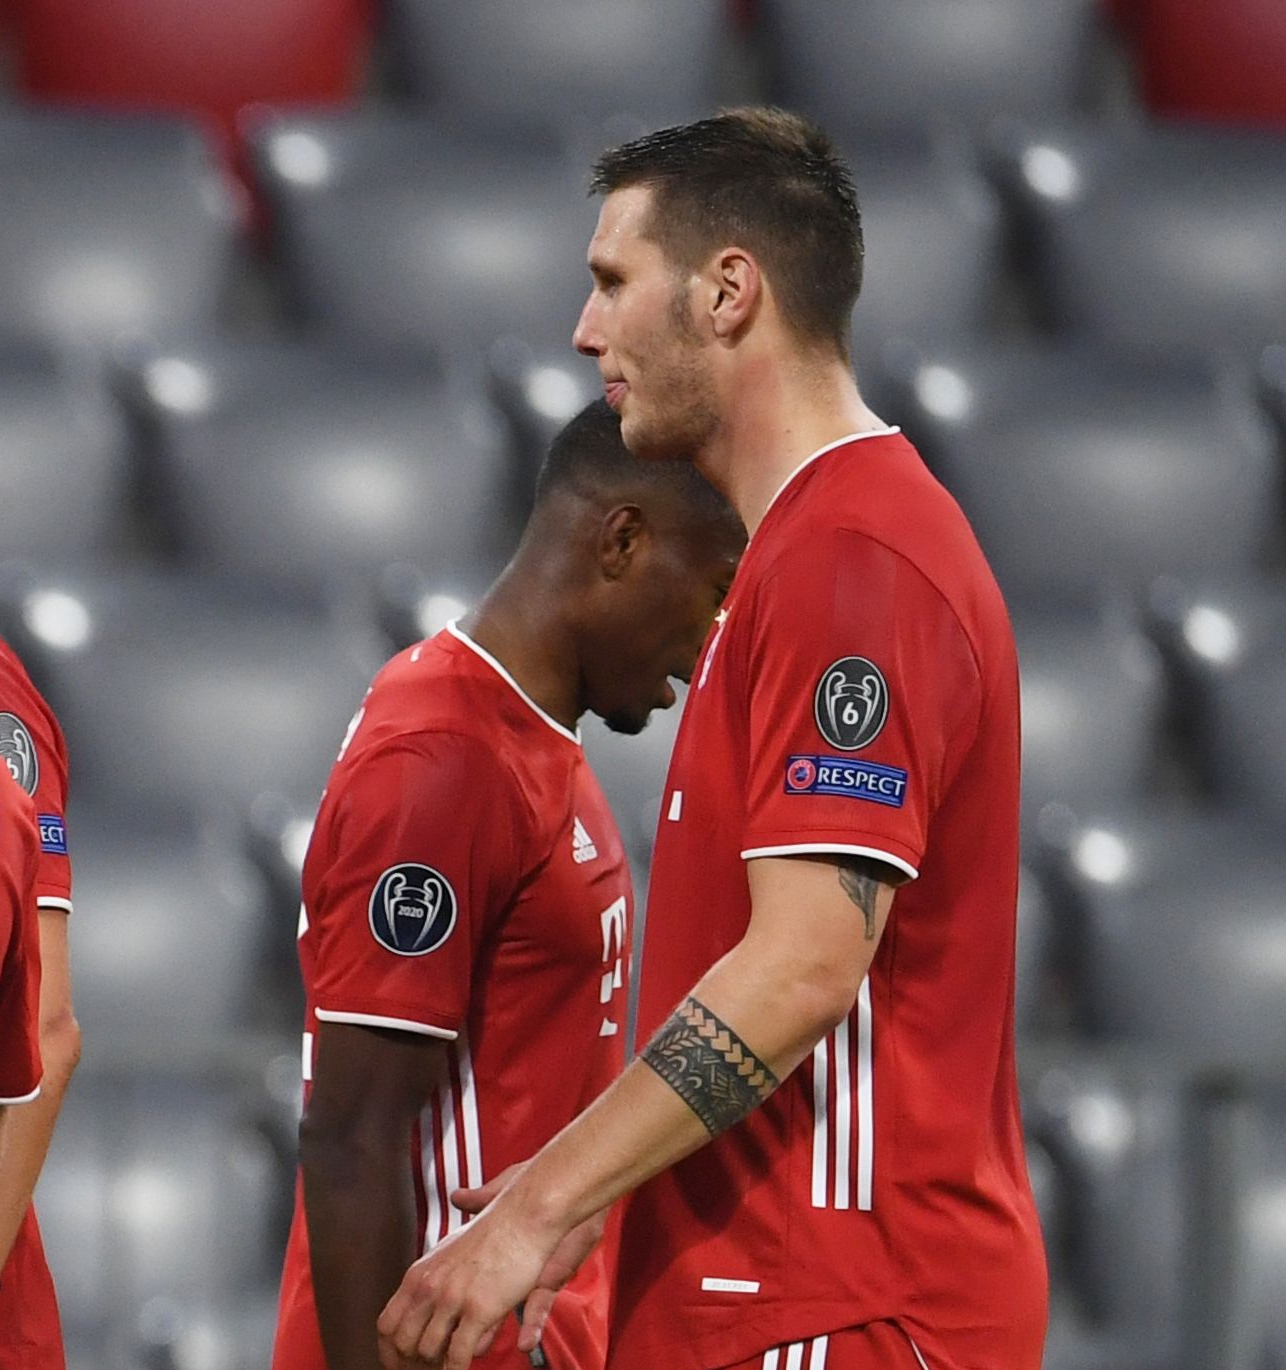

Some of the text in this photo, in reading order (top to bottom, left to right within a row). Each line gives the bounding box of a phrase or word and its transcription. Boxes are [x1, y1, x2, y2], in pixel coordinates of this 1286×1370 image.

[842, 702, 859, 725] 6
[817, 767, 905, 796] RESPECT
[397, 905, 424, 918] 2020
